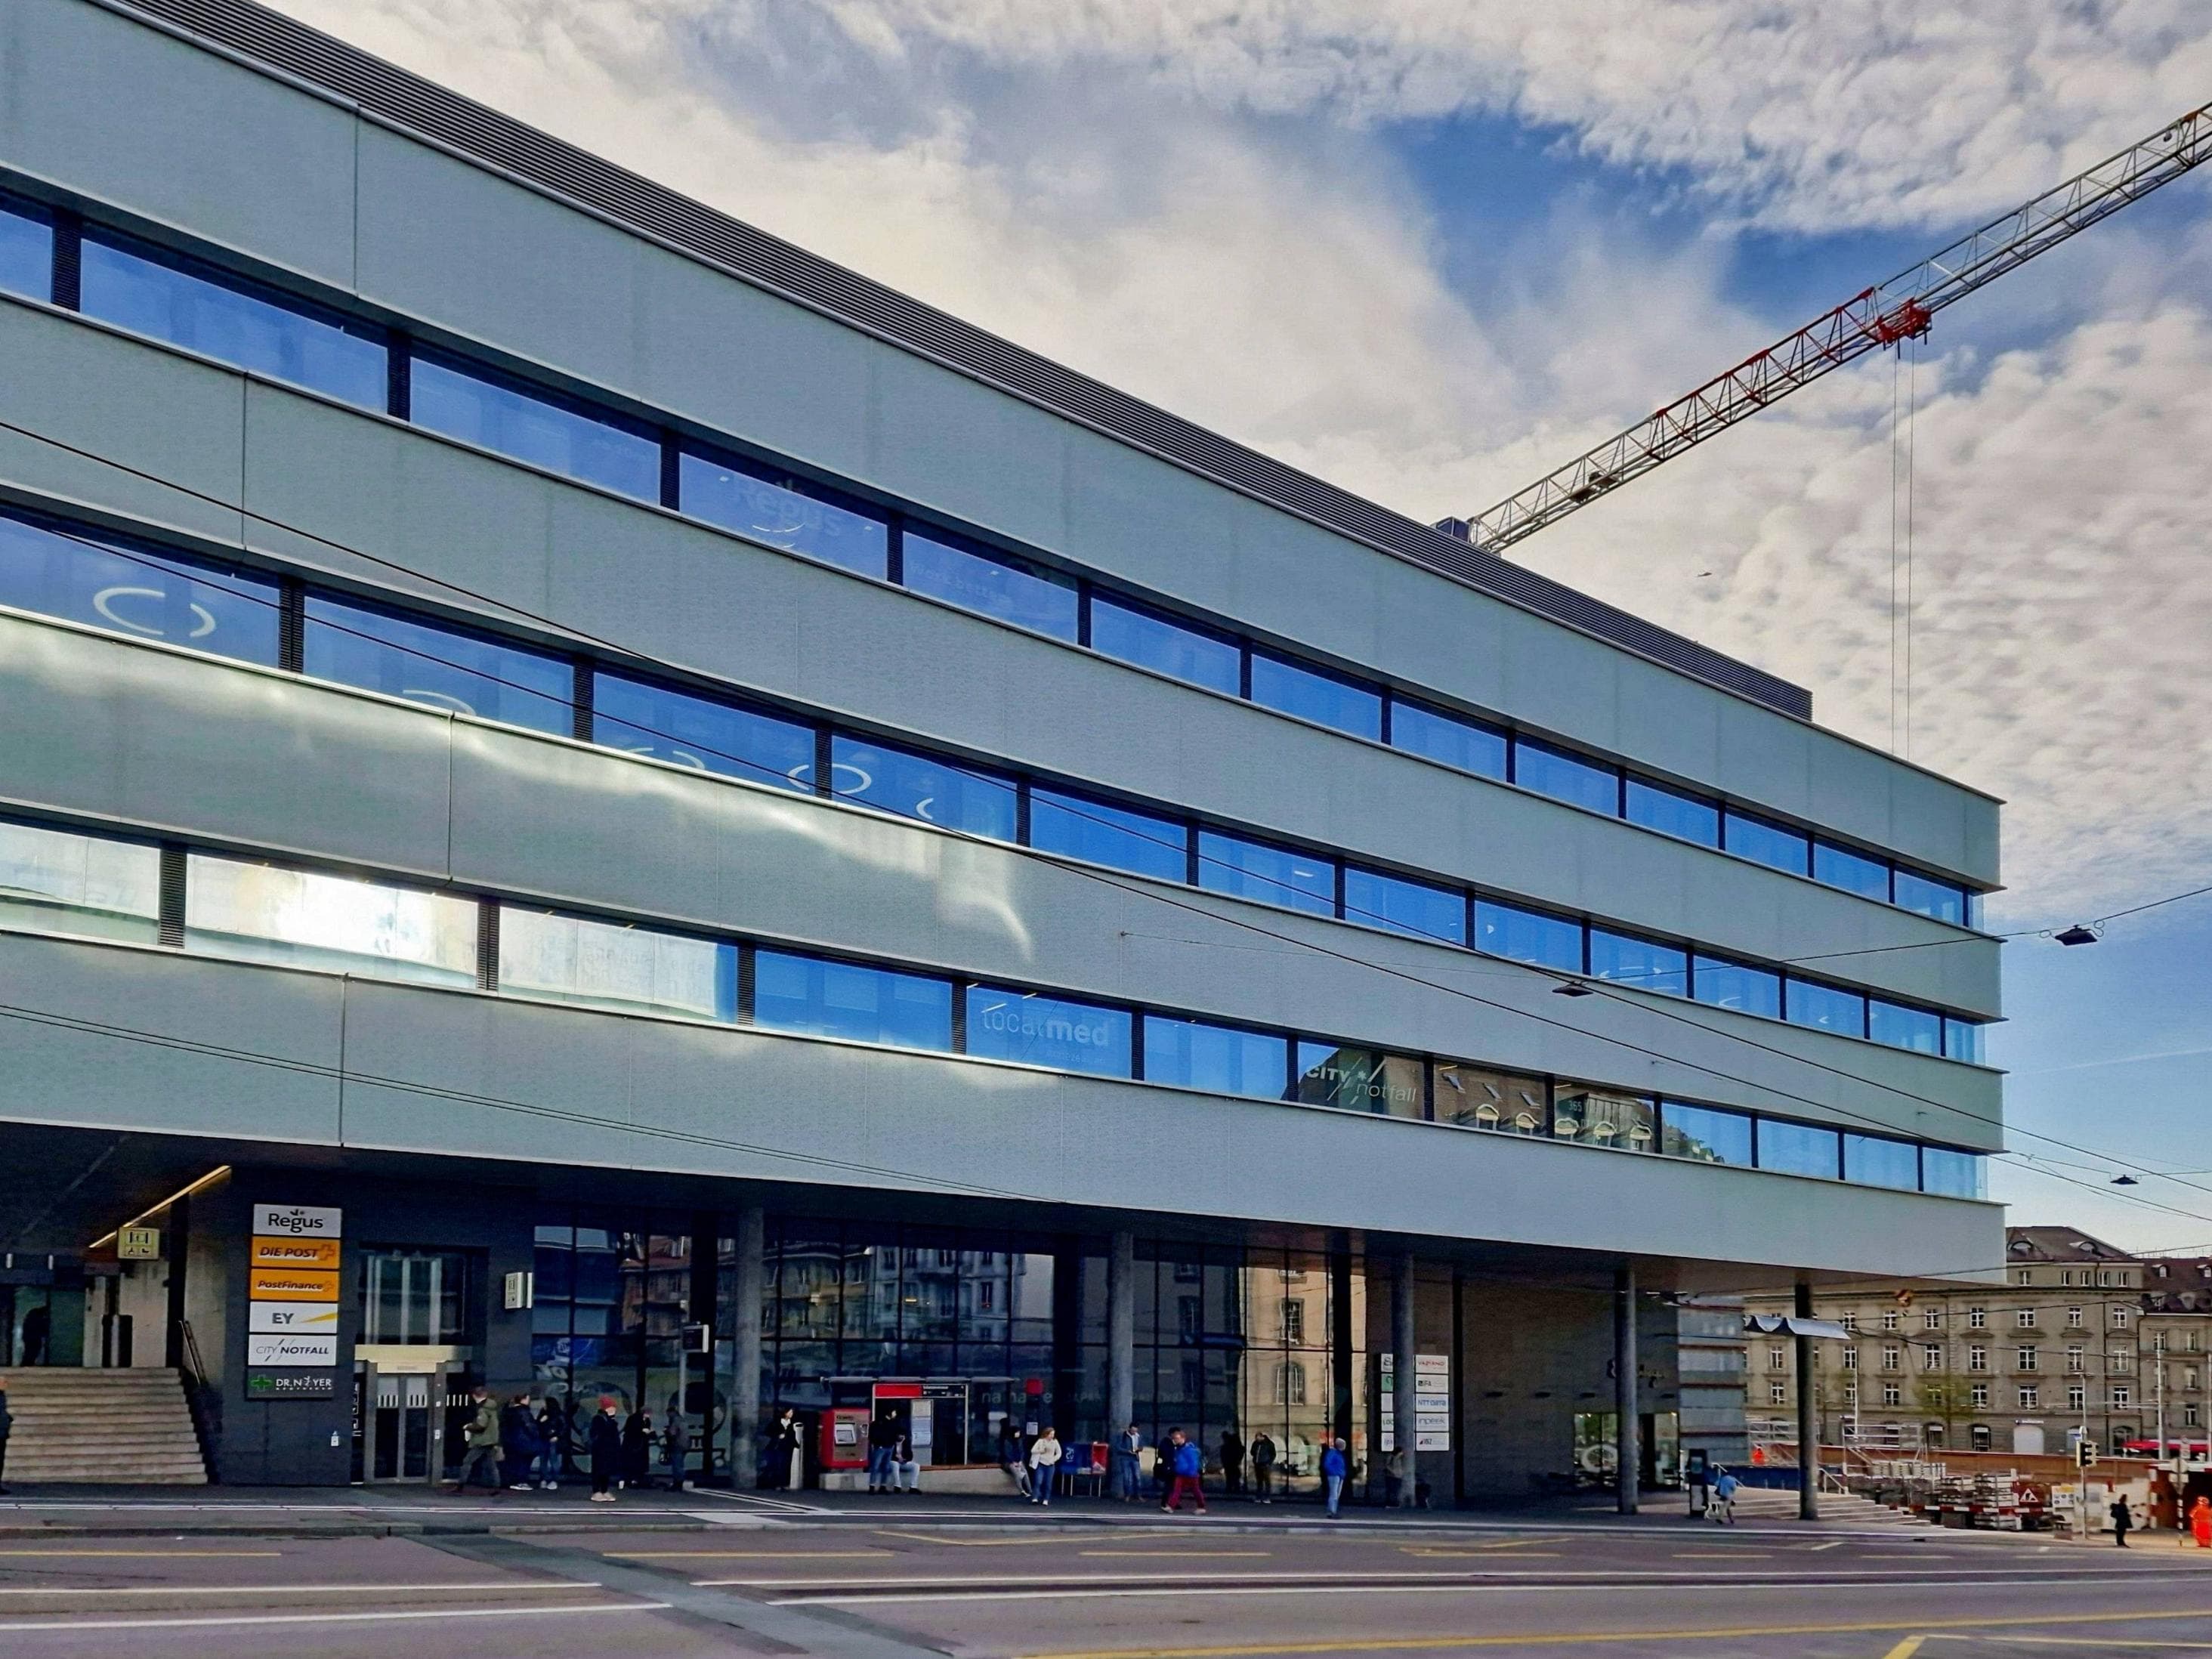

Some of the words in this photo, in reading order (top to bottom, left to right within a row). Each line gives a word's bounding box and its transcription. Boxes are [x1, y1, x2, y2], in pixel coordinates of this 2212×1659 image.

[1306, 1066, 1351, 1083] CITY
[1357, 1083, 1416, 1102] notfall
[268, 1212, 323, 1233] Regus
[260, 1247, 283, 1256] DIE
[284, 1248, 317, 1258] POST
[258, 1280, 323, 1290] PostFinance
[272, 1312, 294, 1324] EY
[256, 1346, 277, 1355] CITY
[280, 1346, 329, 1355] NOTFALL
